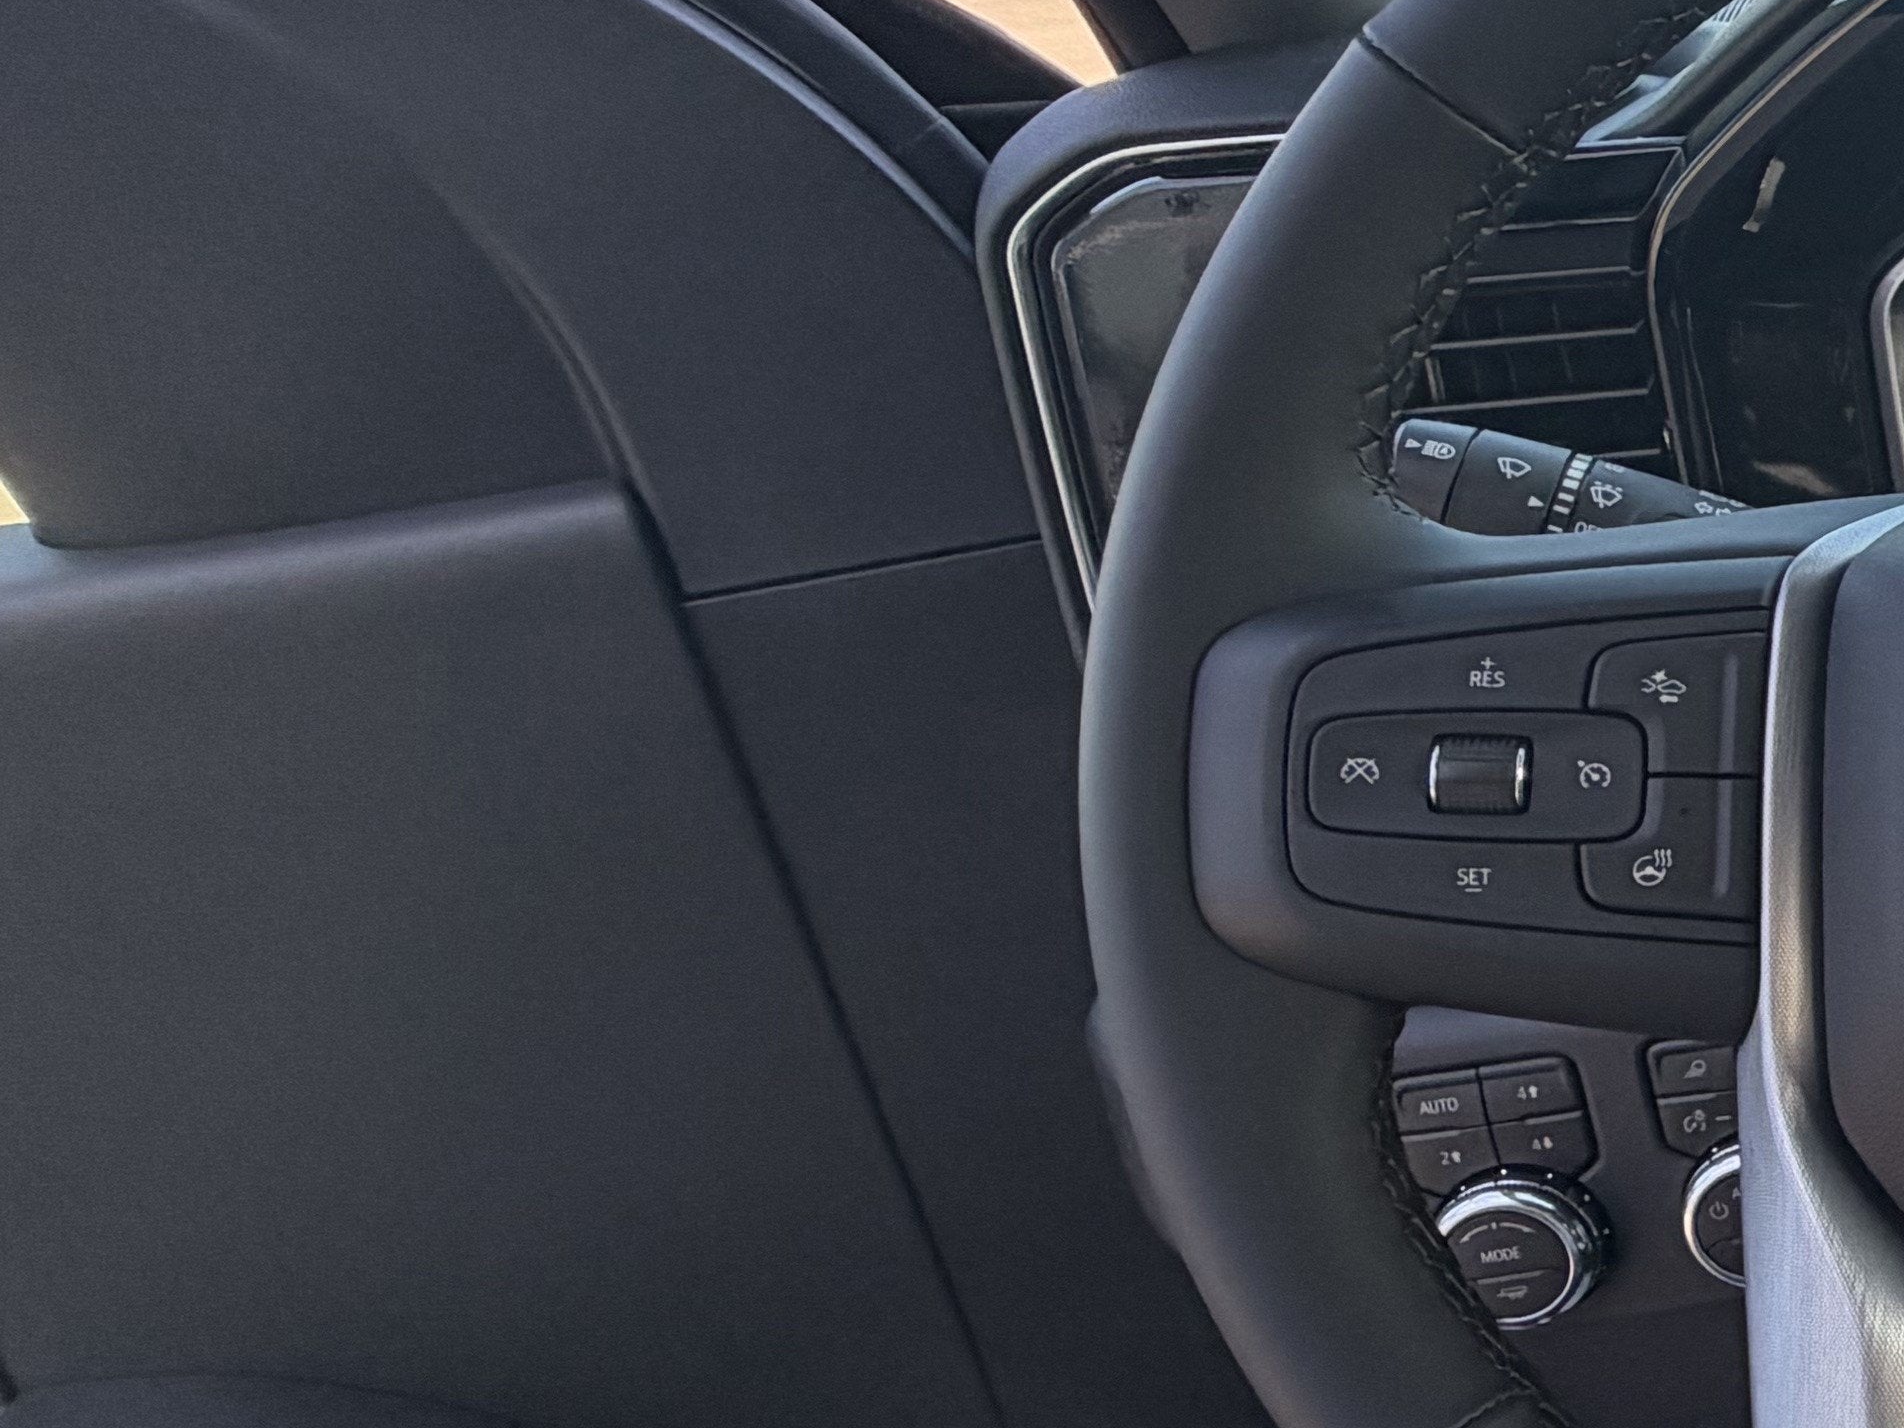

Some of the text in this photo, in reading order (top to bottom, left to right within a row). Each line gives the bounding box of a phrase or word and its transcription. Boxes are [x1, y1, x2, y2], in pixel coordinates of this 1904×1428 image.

[1469, 670, 1506, 689] RES
[1456, 867, 1492, 886] SET
[1418, 1096, 1459, 1116] AUTO
[1479, 1245, 1522, 1264] MODE
